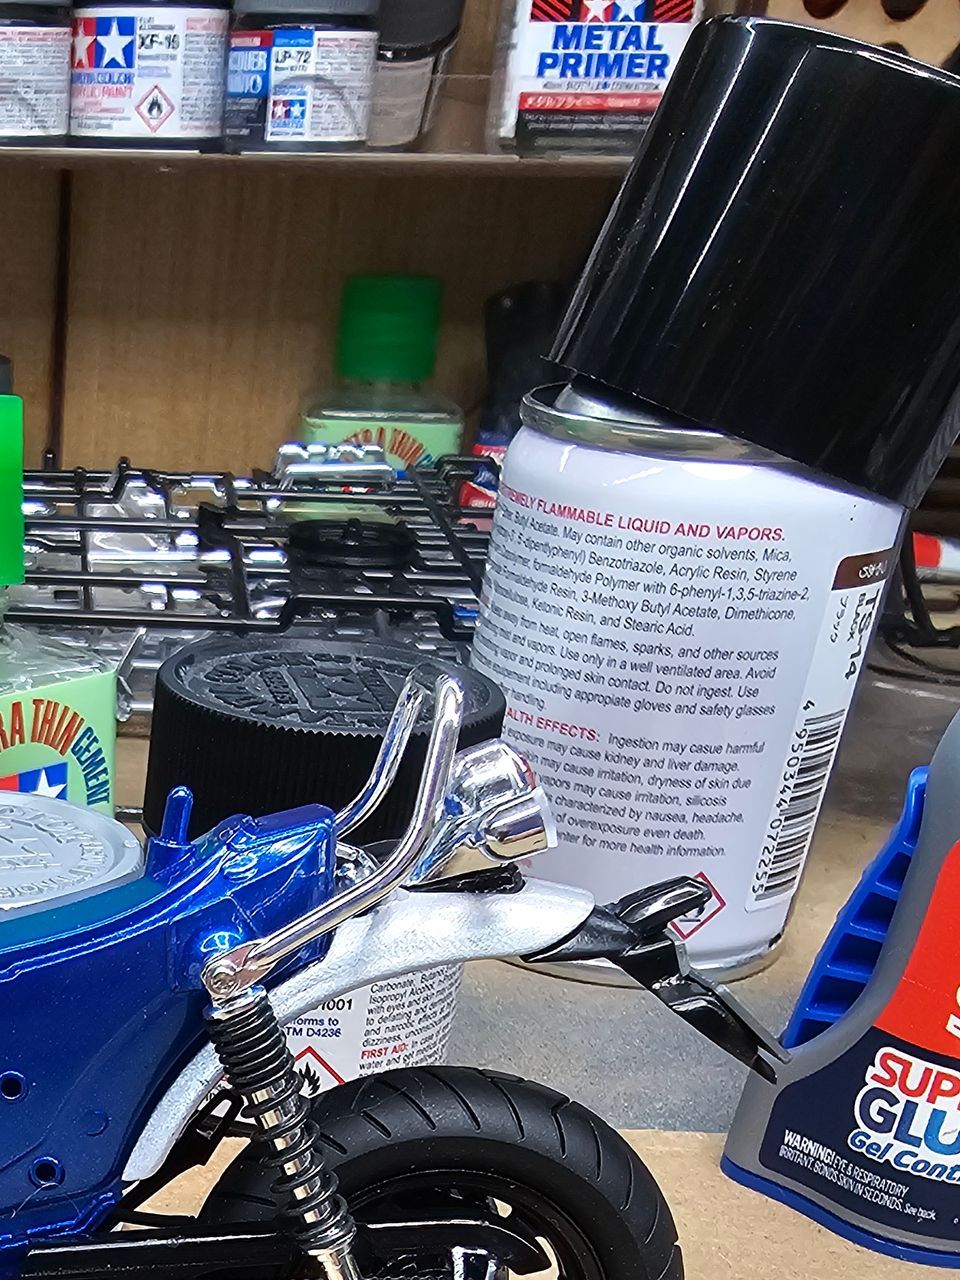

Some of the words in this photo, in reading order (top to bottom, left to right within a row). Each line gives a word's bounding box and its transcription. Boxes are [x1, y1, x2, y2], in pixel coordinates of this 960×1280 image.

[552, 25, 664, 51] METAL
[536, 53, 670, 79] PRIMER
[537, 500, 614, 527] FLAMMABLE
[618, 515, 670, 534] LIQUID
[674, 523, 711, 538] AND
[716, 525, 786, 541] VAPORS.
[563, 526, 582, 544] May
[585, 533, 622, 549] contain
[625, 539, 655, 553] other
[658, 543, 703, 560] organic
[706, 547, 759, 562] solvents,
[763, 548, 792, 562] Mica,
[595, 572, 640, 591] Polymer
[643, 582, 667, 596] with
[669, 563, 710, 581] Acrylic
[713, 566, 750, 582] Resin,
[754, 567, 797, 584] Styrene
[581, 590, 638, 614] 3-Methoxy
[641, 599, 671, 617] Butyl
[672, 602, 721, 620] Acetate,
[566, 606, 596, 624] Resin,
[600, 614, 621, 628] and
[624, 617, 664, 634] Stearic
[665, 622, 695, 637] Acid.
[845, 589, 881, 680] TS-14
[562, 630, 588, 645] open
[633, 642, 673, 658] sparks,
[678, 647, 701, 660] and
[703, 648, 734, 661] other
[736, 650, 779, 662] sources
[560, 646, 580, 662] Use
[581, 651, 606, 669] only
[630, 661, 653, 674] well
[656, 664, 712, 679] ventilated
[714, 668, 742, 680] area.
[745, 667, 777, 680] Avoid
[584, 671, 605, 686] skin
[655, 680, 672, 695] Do
[675, 685, 695, 697] not
[697, 686, 734, 701] ingest.
[737, 685, 759, 698] Use
[633, 699, 672, 713] gloves
[675, 703, 697, 716] and
[699, 703, 734, 719] safety
[735, 704, 776, 719] glasses
[803, 700, 816, 711] 4
[536, 717, 601, 743] EFFECTS:
[608, 732, 659, 750] Ingestion
[662, 741, 688, 756] may
[725, 741, 766, 755] harmful
[31, 698, 85, 756] THIN
[71, 726, 111, 806] CEMENT
[546, 740, 569, 757] may
[570, 747, 601, 761] cause
[604, 750, 642, 769] kidney
[643, 757, 665, 770] and
[667, 758, 692, 771] liver
[563, 763, 594, 778] cause
[647, 775, 692, 790] dryness
[694, 777, 708, 789] of
[708, 777, 730, 790] skin
[732, 777, 752, 790] due
[777, 728, 808, 810] 950344
[574, 782, 596, 799] may
[599, 787, 632, 801] cause
[629, 806, 642, 822] by
[599, 838, 628, 852] more
[643, 828, 671, 839] even
[752, 817, 784, 894] 072255
[328, 1017, 339, 1026] to
[365, 1017, 374, 1027] to
[367, 1005, 385, 1016] with
[307, 1027, 342, 1037] D4236
[364, 1026, 381, 1038] and
[361, 1046, 389, 1060] FIRST
[870, 1051, 960, 1110] SUP
[849, 1132, 895, 1159] Gel
[783, 1129, 837, 1164] WARNING!
[833, 1157, 848, 1174] EYE
[852, 1165, 909, 1198] RESPIRATORY
[836, 1173, 855, 1194] SKIN
[862, 1183, 903, 1212] SECONDS.
